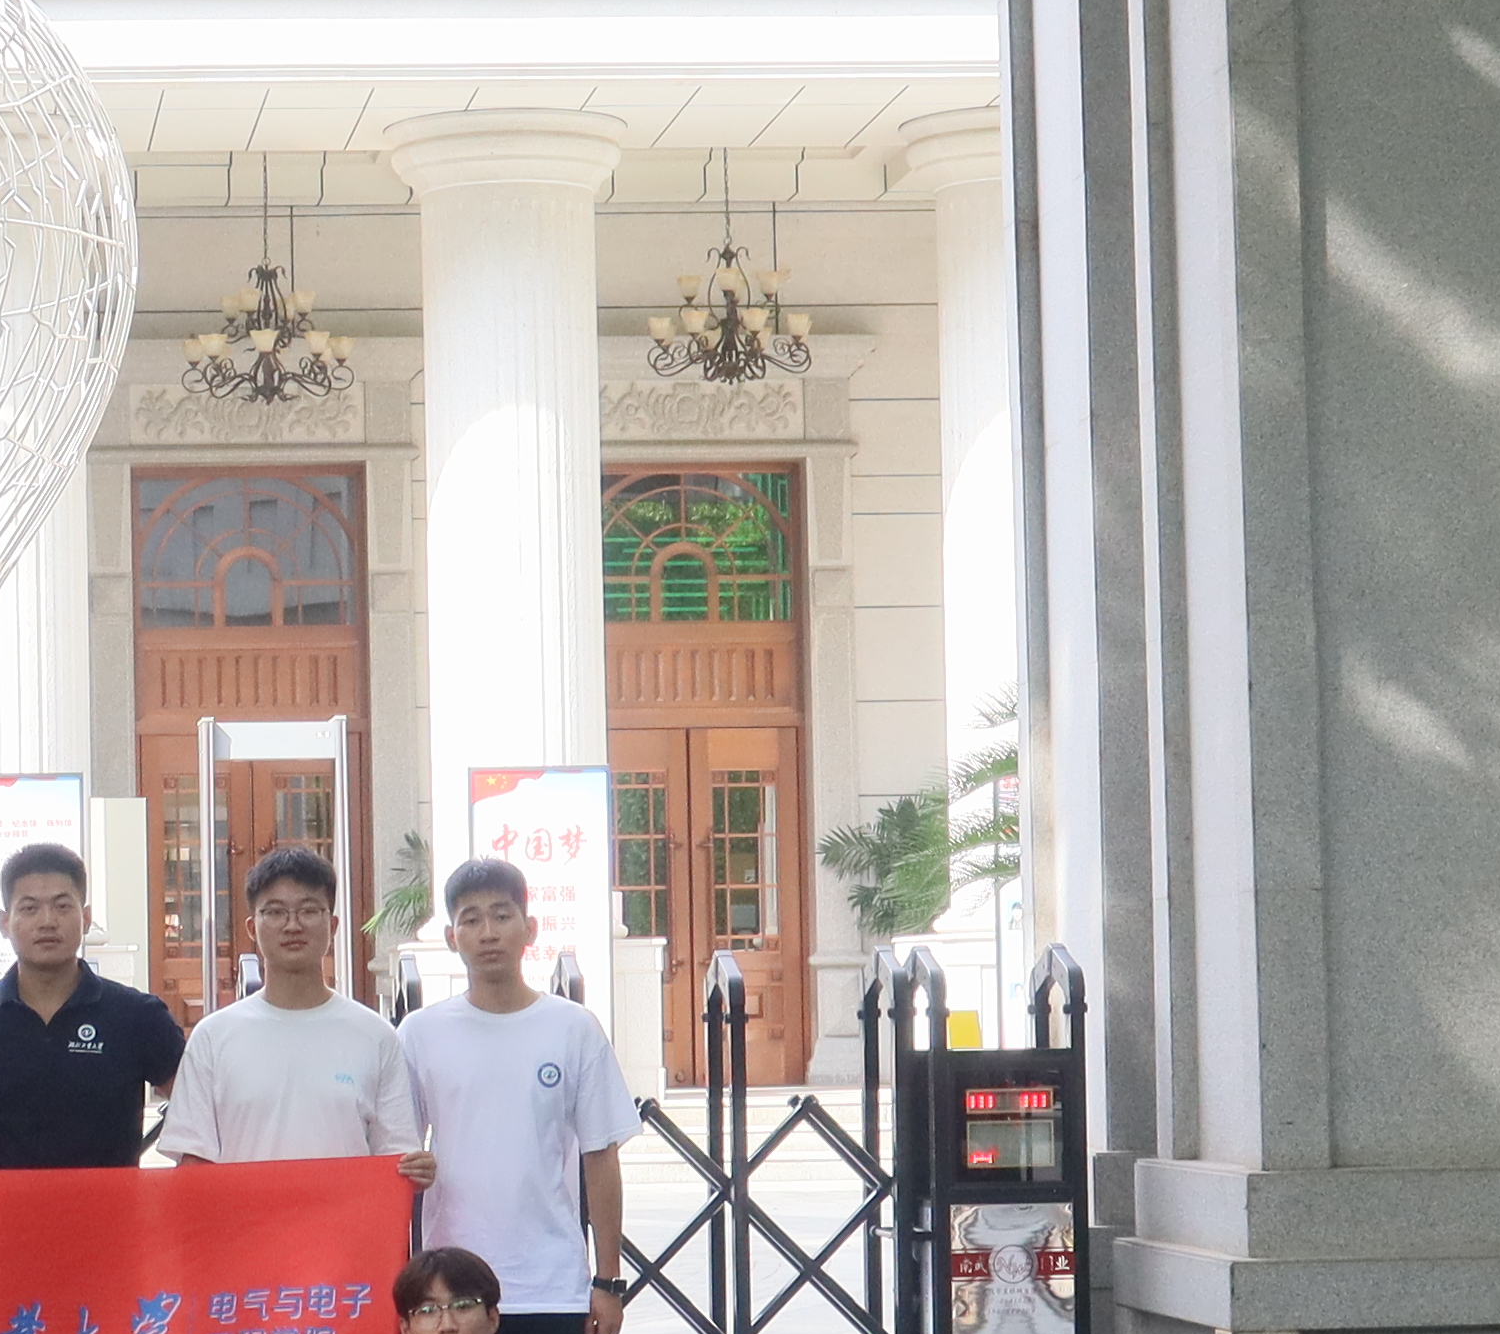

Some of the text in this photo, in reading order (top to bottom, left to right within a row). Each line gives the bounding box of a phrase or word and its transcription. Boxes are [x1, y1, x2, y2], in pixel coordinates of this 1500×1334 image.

[491, 823, 588, 866] 中国梦
[537, 915, 577, 932] 振兴
[207, 1283, 373, 1325] 电气与电子
